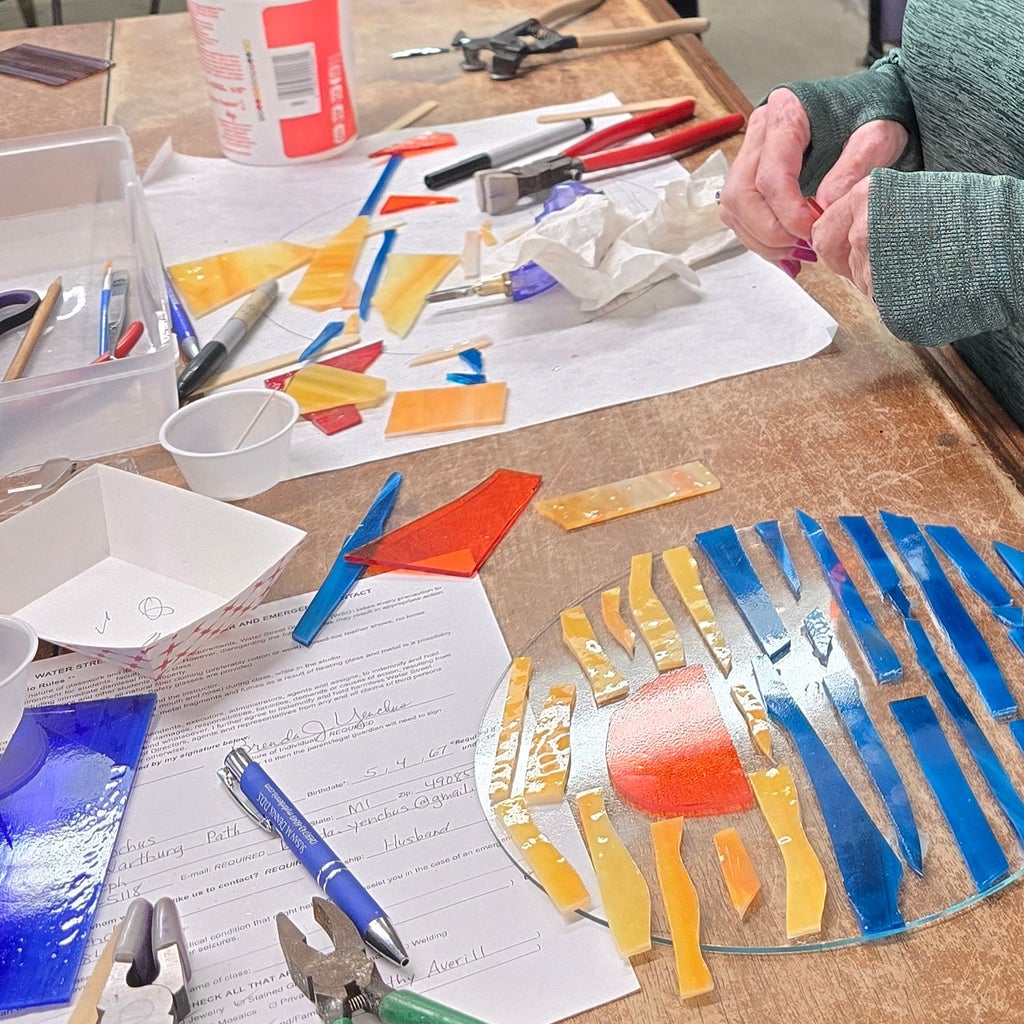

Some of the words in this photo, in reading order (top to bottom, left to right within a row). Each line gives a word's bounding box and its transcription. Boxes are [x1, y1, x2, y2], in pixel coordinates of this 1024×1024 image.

[376, 598, 396, 608] every
[397, 589, 433, 604] precaution
[34, 666, 73, 680] WATER
[75, 659, 105, 670] STRE
[239, 618, 260, 628] AND
[263, 605, 309, 621] EMERGE
[342, 588, 372, 601] NTACT
[220, 638, 266, 653] disregarding
[240, 634, 262, 644] Water
[38, 678, 65, 689] Rules
[174, 676, 204, 689] glasses
[220, 662, 254, 677] provided
[183, 693, 223, 710] fragments
[315, 660, 343, 674] heating
[344, 654, 365, 667] glass
[225, 679, 250, 692] during
[318, 654, 341, 665] studio
[286, 686, 311, 699] agents
[371, 660, 407, 675] indemnify
[408, 654, 423, 664] and
[423, 650, 440, 660] hold
[293, 688, 328, 704] demands
[340, 677, 366, 690] causes
[402, 658, 434, 673] resulting
[435, 652, 452, 662] from
[192, 730, 219, 744] agents
[237, 707, 297, 729] representatives
[360, 683, 385, 696] claims
[412, 666, 442, 680] persons
[243, 712, 267, 724] agree
[278, 697, 316, 714] indemnify
[332, 687, 350, 697] hold
[350, 677, 385, 693] harmless
[386, 670, 409, 682] Water
[351, 723, 384, 739] guardian
[398, 714, 417, 725] need
[427, 707, 442, 718] sign
[164, 754, 177, 765] my
[180, 742, 221, 759] signature
[424, 769, 471, 789] 49085
[206, 822, 241, 844] Path
[383, 822, 450, 851] Husband
[180, 866, 211, 881] E-mail:
[214, 849, 266, 871] REQUIRED
[218, 871, 260, 890] contact?
[264, 859, 303, 876] REQUIR
[387, 873, 404, 885] you
[414, 864, 429, 874] the
[430, 857, 451, 869] case
[210, 921, 252, 942] condition
[252, 914, 271, 927] that
[411, 930, 449, 948] Welding
[224, 967, 252, 982] class:
[427, 945, 486, 978] Averill
[191, 993, 223, 1009] HECK
[224, 986, 246, 997] ALL
[249, 975, 277, 989] THAT
[280, 993, 306, 1007] Priva
